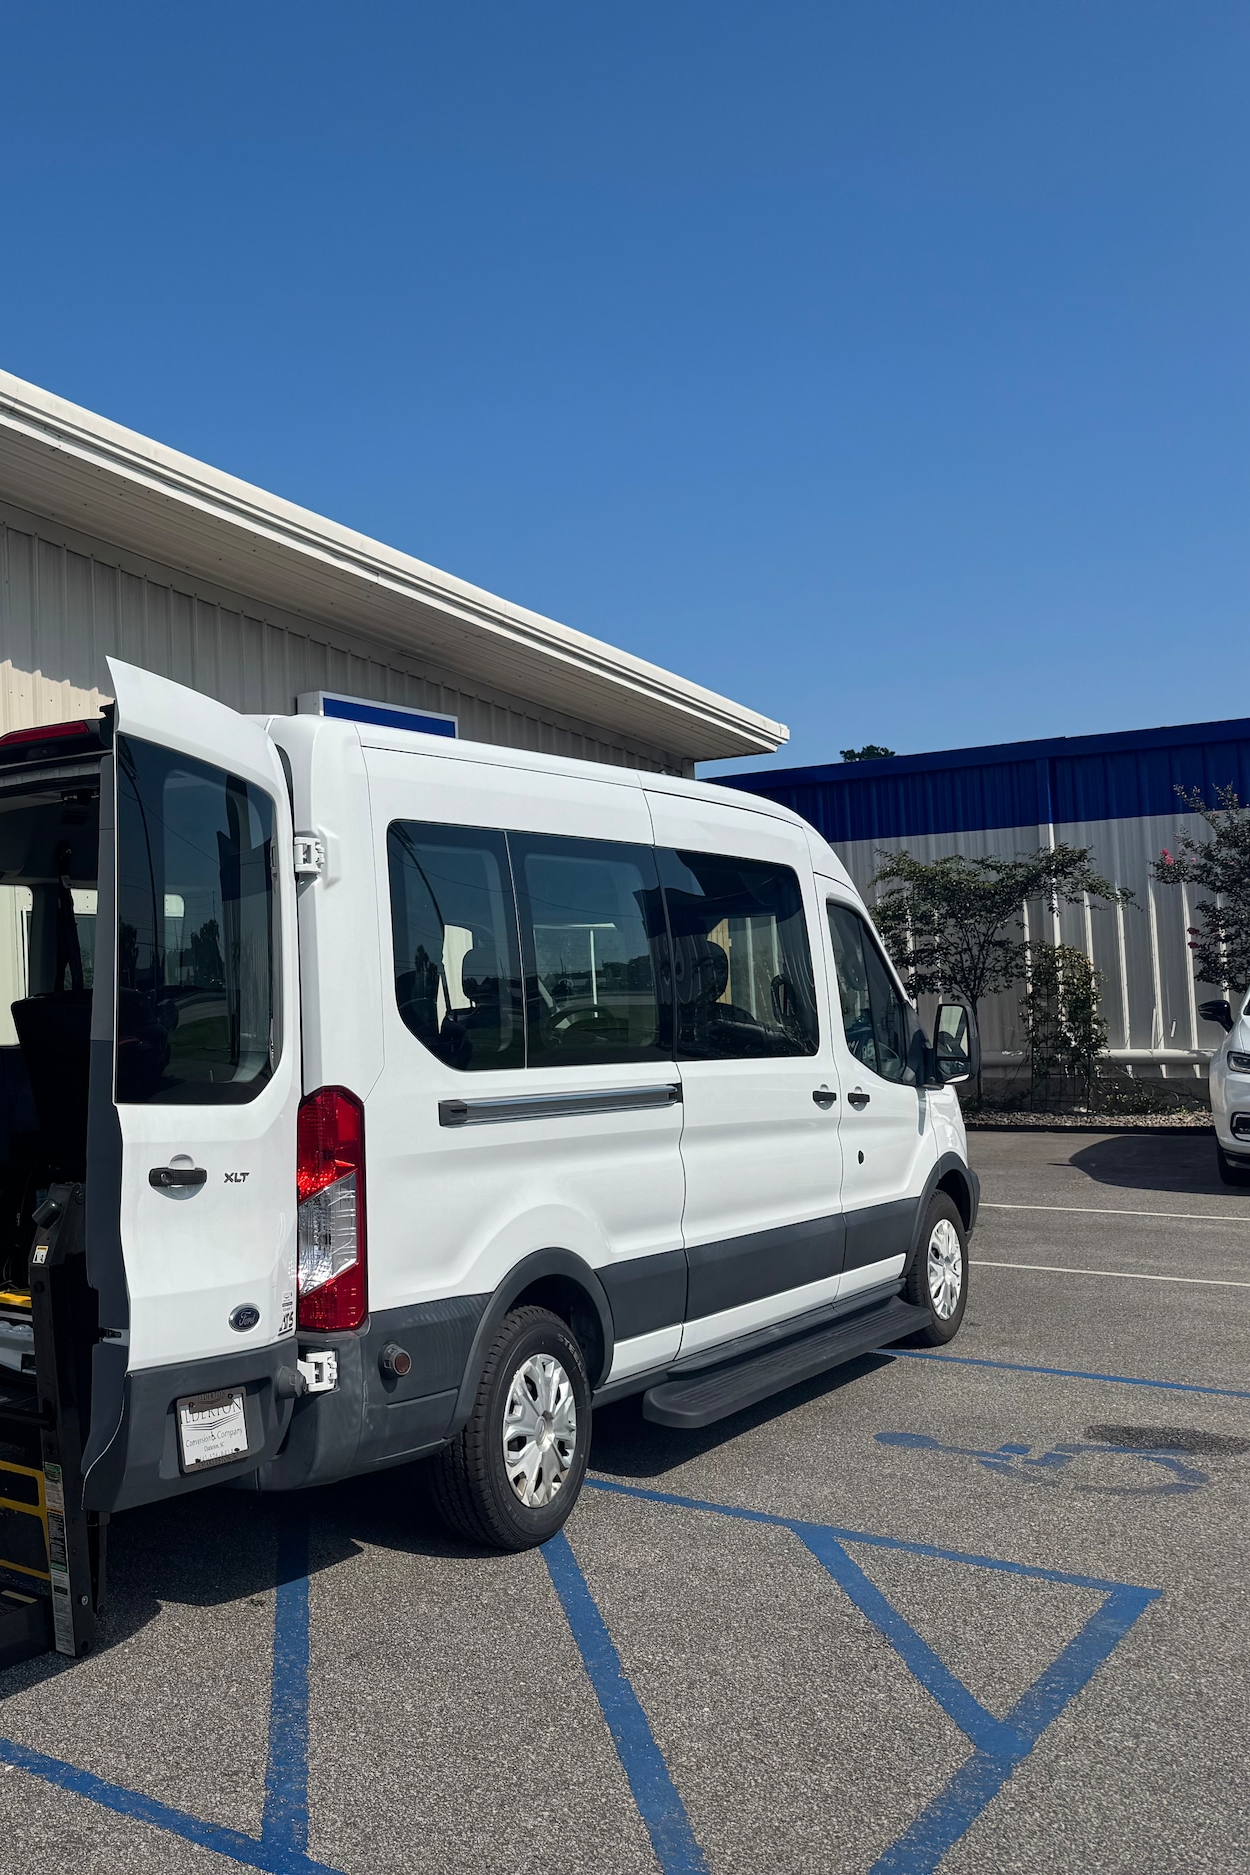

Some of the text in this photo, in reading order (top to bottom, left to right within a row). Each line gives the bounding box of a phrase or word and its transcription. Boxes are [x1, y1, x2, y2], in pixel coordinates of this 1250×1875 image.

[223, 1172, 250, 1183] XLT
[238, 1311, 256, 1326] Ford
[216, 1428, 243, 1440] Company
